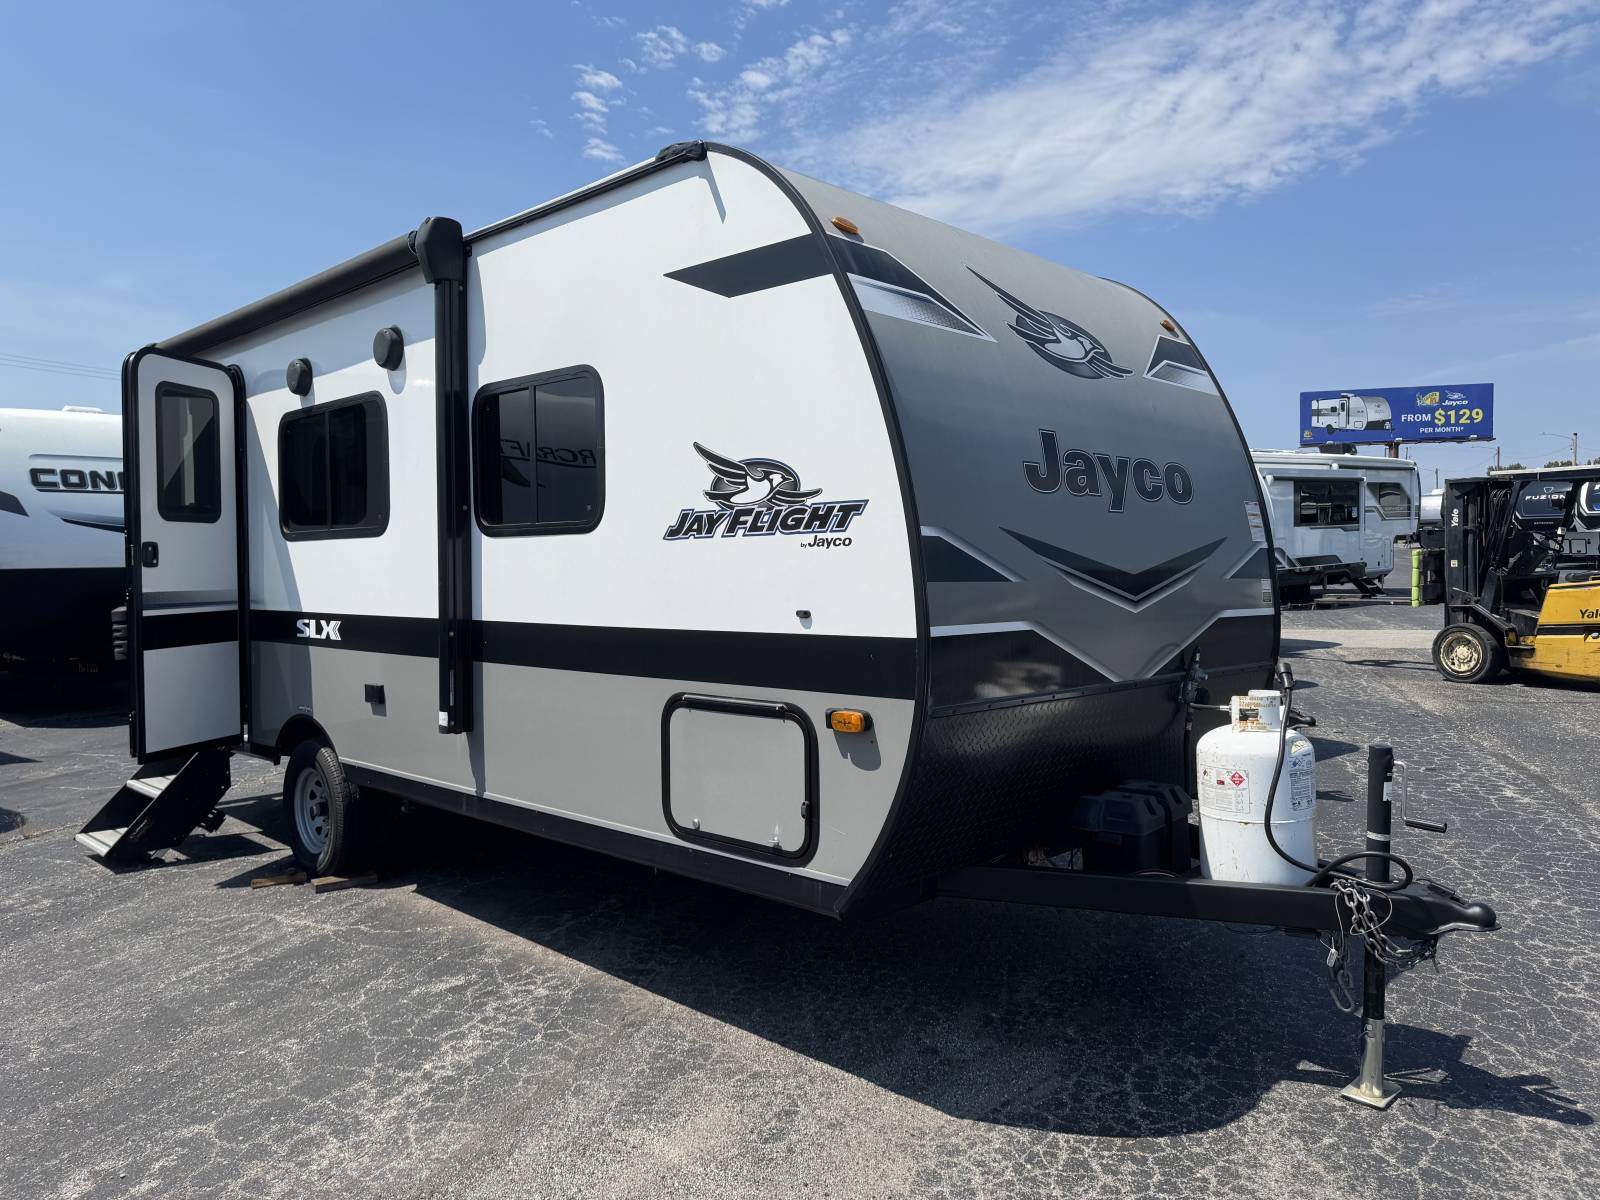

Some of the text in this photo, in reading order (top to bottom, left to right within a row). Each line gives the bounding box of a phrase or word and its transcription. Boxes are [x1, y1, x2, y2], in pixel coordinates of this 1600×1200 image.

[1401, 408, 1483, 425] FROM $129
[1023, 429, 1194, 513] Jayco
[662, 499, 869, 540] JAY FLIGHT
[1451, 508, 1459, 527] Yale
[808, 535, 852, 549] Jayco
[1580, 609, 1600, 619] Yal
[296, 619, 341, 640] SLX
